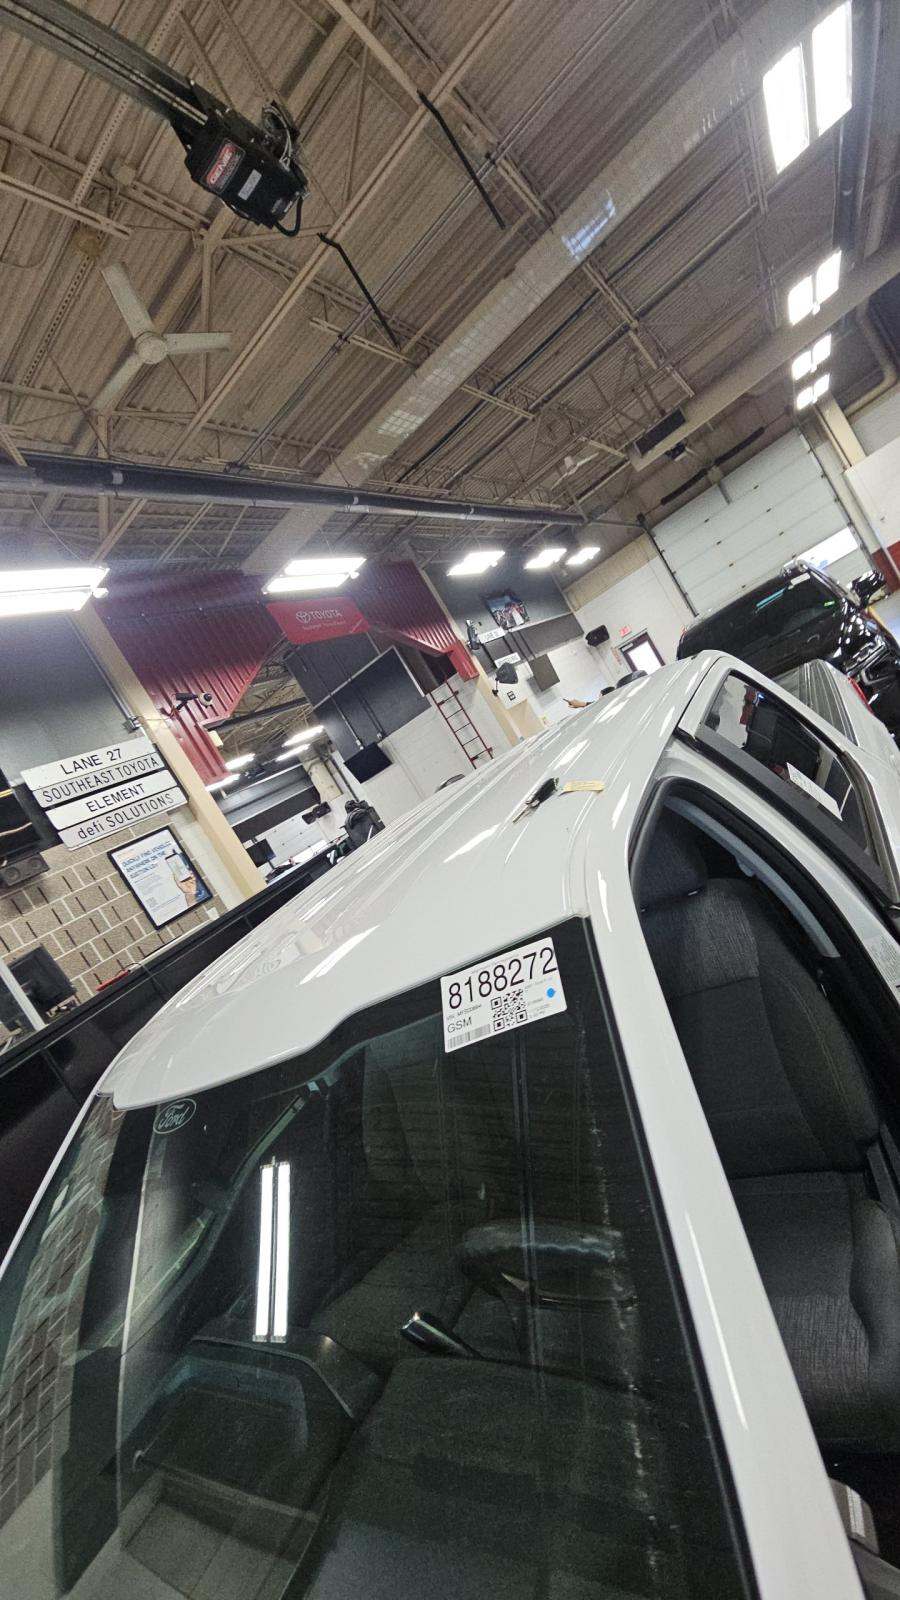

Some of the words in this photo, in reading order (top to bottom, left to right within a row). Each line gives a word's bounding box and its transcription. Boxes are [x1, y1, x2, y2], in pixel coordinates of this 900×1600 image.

[311, 609, 343, 619] TOYOTA
[60, 754, 102, 775] LANE
[106, 748, 122, 762] 27
[42, 770, 116, 803] SOUTHEAST
[116, 757, 160, 777] TOYOTA
[85, 783, 145, 812] ELEMENT
[77, 820, 105, 839] defi
[105, 793, 175, 827] SOLUTIONS
[448, 947, 558, 1009] 8188272
[447, 1017, 472, 1033] GSM
[157, 1103, 190, 1130] Ford
